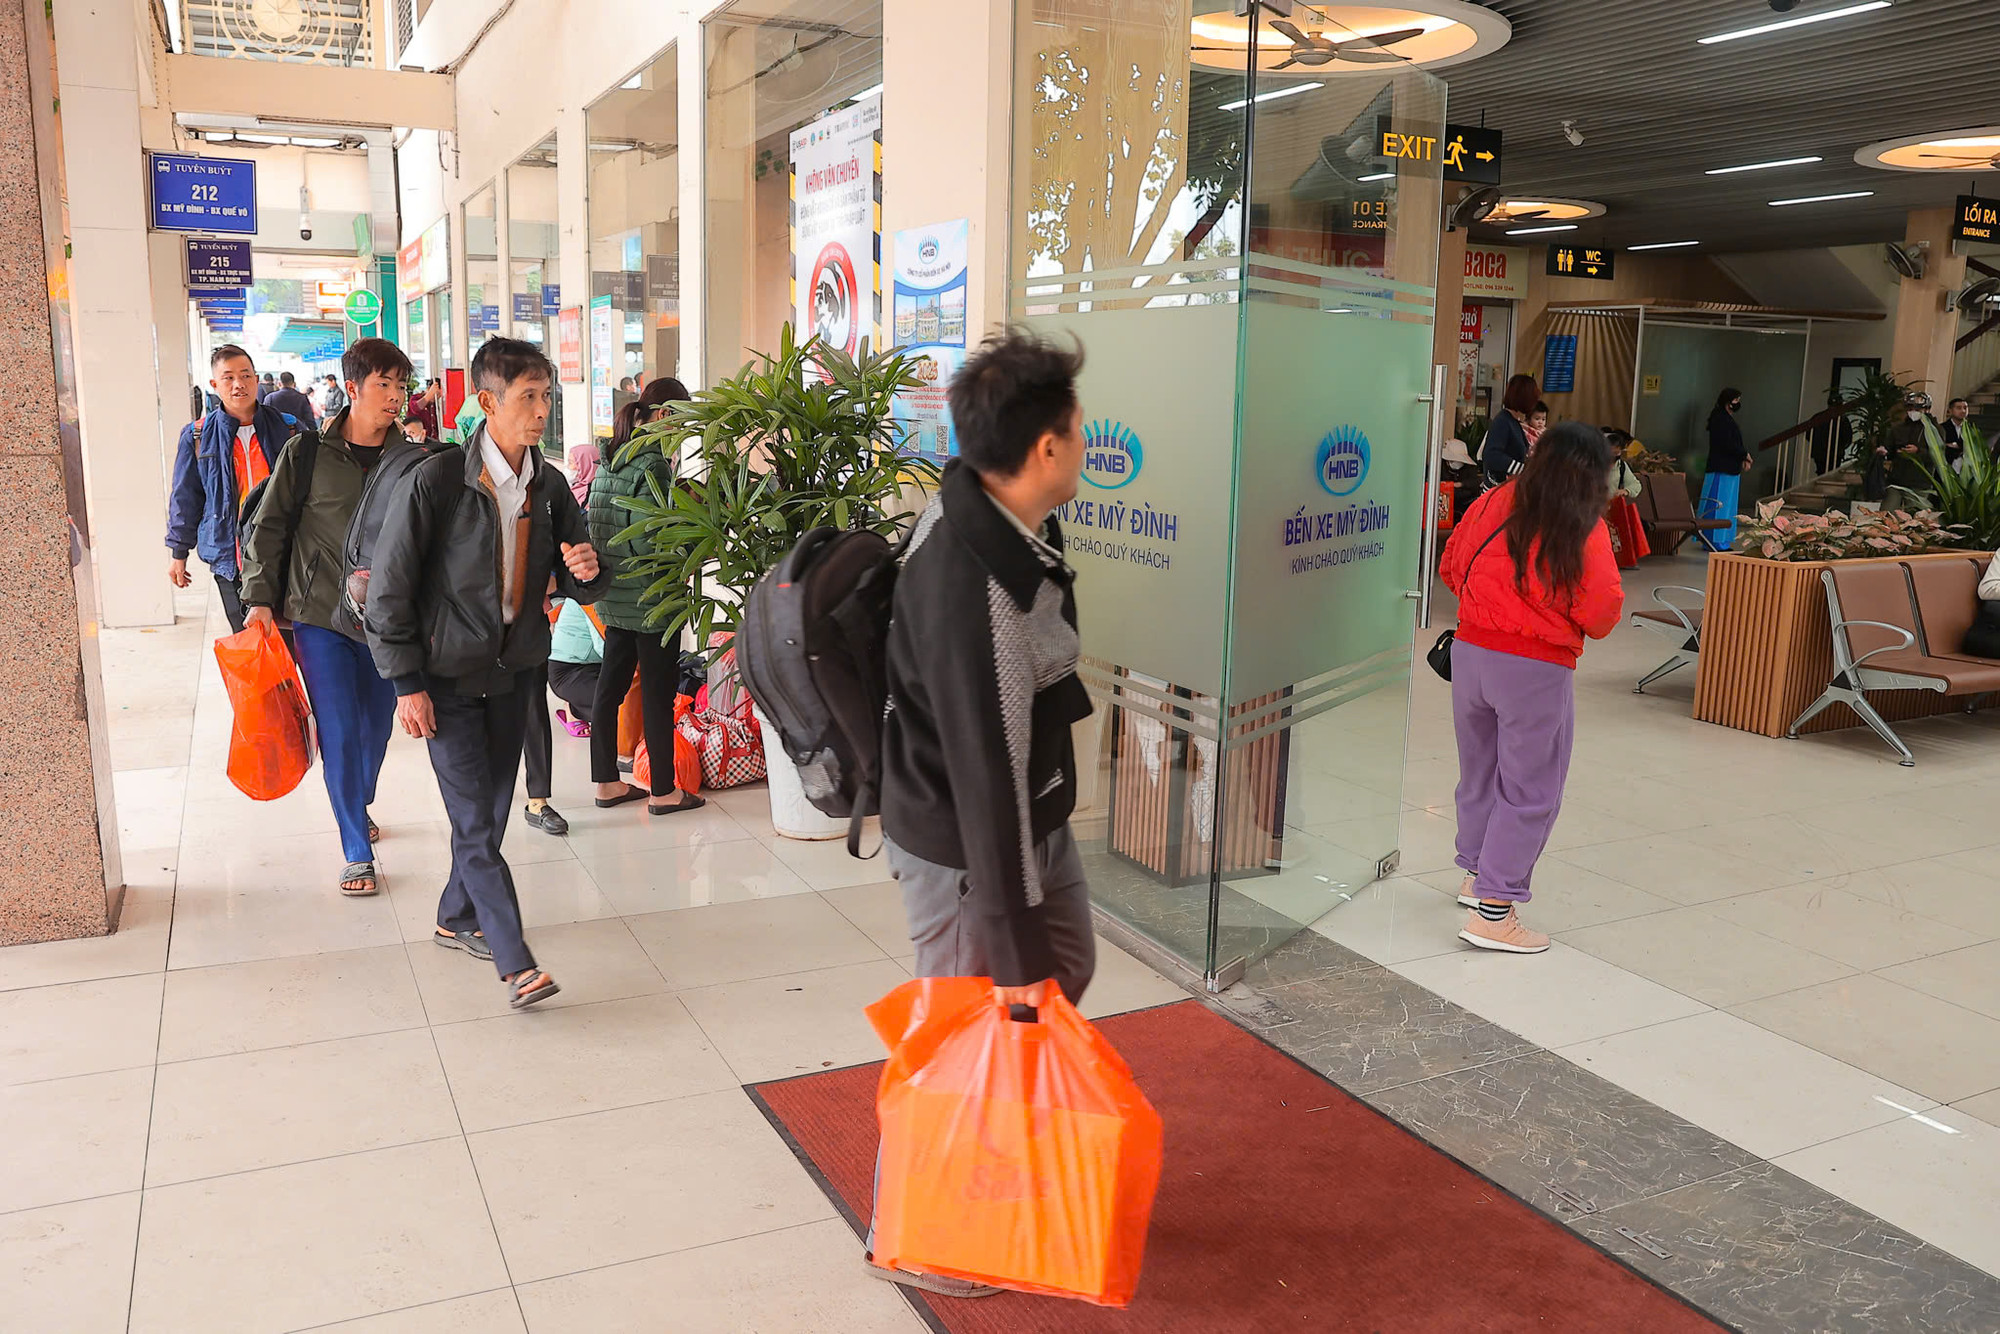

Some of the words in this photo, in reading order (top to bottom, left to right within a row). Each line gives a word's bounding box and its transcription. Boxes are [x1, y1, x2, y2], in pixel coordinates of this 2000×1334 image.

[1382, 132, 1436, 160] EXIT
[175, 163, 206, 174] TUYẾN
[207, 164, 233, 176] BUÝT
[191, 184, 219, 201] 212
[161, 204, 172, 212] BX
[173, 203, 185, 213] MỸ
[186, 204, 205, 214] ĐÌNH
[210, 207, 221, 215] BX
[222, 205, 237, 216] QUẾ
[1964, 202, 1982, 222] LỐI
[1983, 209, 1997, 225] RA
[1962, 226, 1990, 238] ENTRANCE
[210, 256, 230, 268] 215
[922, 248, 935, 258] HNB
[1585, 250, 1601, 262] WC
[917, 359, 939, 381] 2025
[1086, 452, 1126, 474] HNB
[1328, 459, 1359, 480] HNB
[1073, 499, 1094, 527] XE
[1098, 500, 1126, 532] MỸ
[1130, 502, 1177, 542] ĐÌNH
[1285, 505, 1313, 546] BẾN
[1316, 513, 1334, 541] XE
[1336, 504, 1358, 537] MỸ
[1359, 499, 1390, 533] ĐÌNH
[1073, 536, 1101, 556] CHÀO
[1104, 543, 1127, 561] QUÝ
[1130, 547, 1170, 570] KHÁCH
[1291, 552, 1314, 575] KÍNH
[1314, 548, 1339, 570] CHÀO
[1340, 543, 1359, 564] QUÝ
[1358, 541, 1385, 560] KHÁCH
